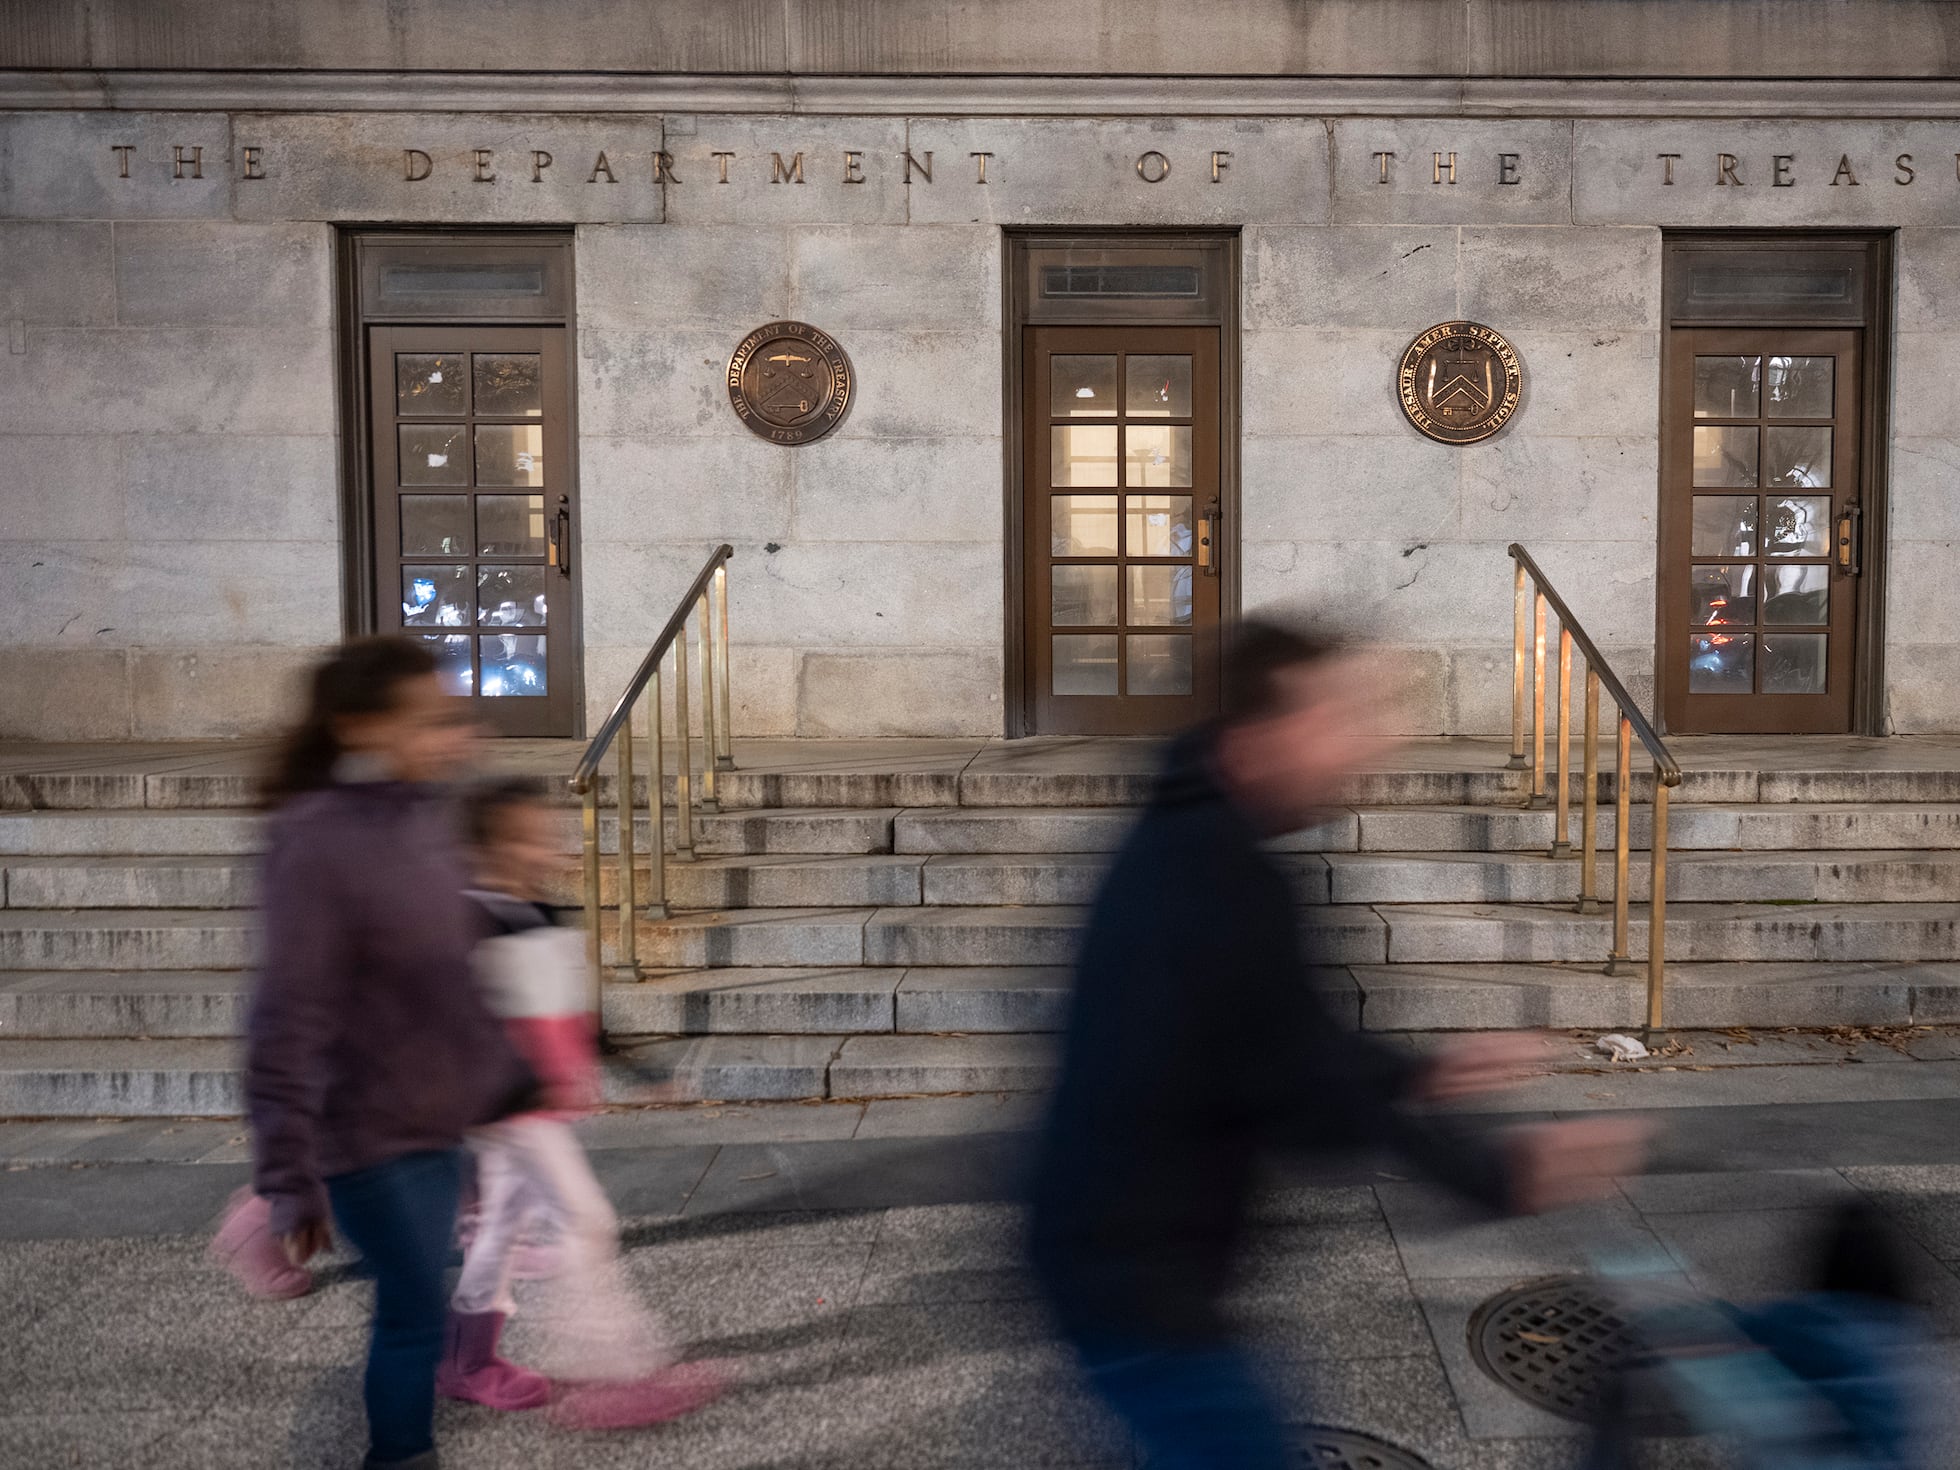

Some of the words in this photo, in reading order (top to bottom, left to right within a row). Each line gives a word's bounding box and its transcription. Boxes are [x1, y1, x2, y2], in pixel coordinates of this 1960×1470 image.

[111, 145, 267, 180] THE
[403, 149, 995, 185] DEPARTMENT
[1136, 150, 1235, 184] OF
[1372, 151, 1521, 186] THE
[1656, 152, 1960, 188] TREAS
[788, 324, 807, 336] OF
[811, 331, 834, 354] THE
[730, 324, 782, 387] DEPARTMENT
[827, 358, 847, 421] TREASURY
[733, 394, 749, 420] THE
[771, 429, 803, 440] 1789
